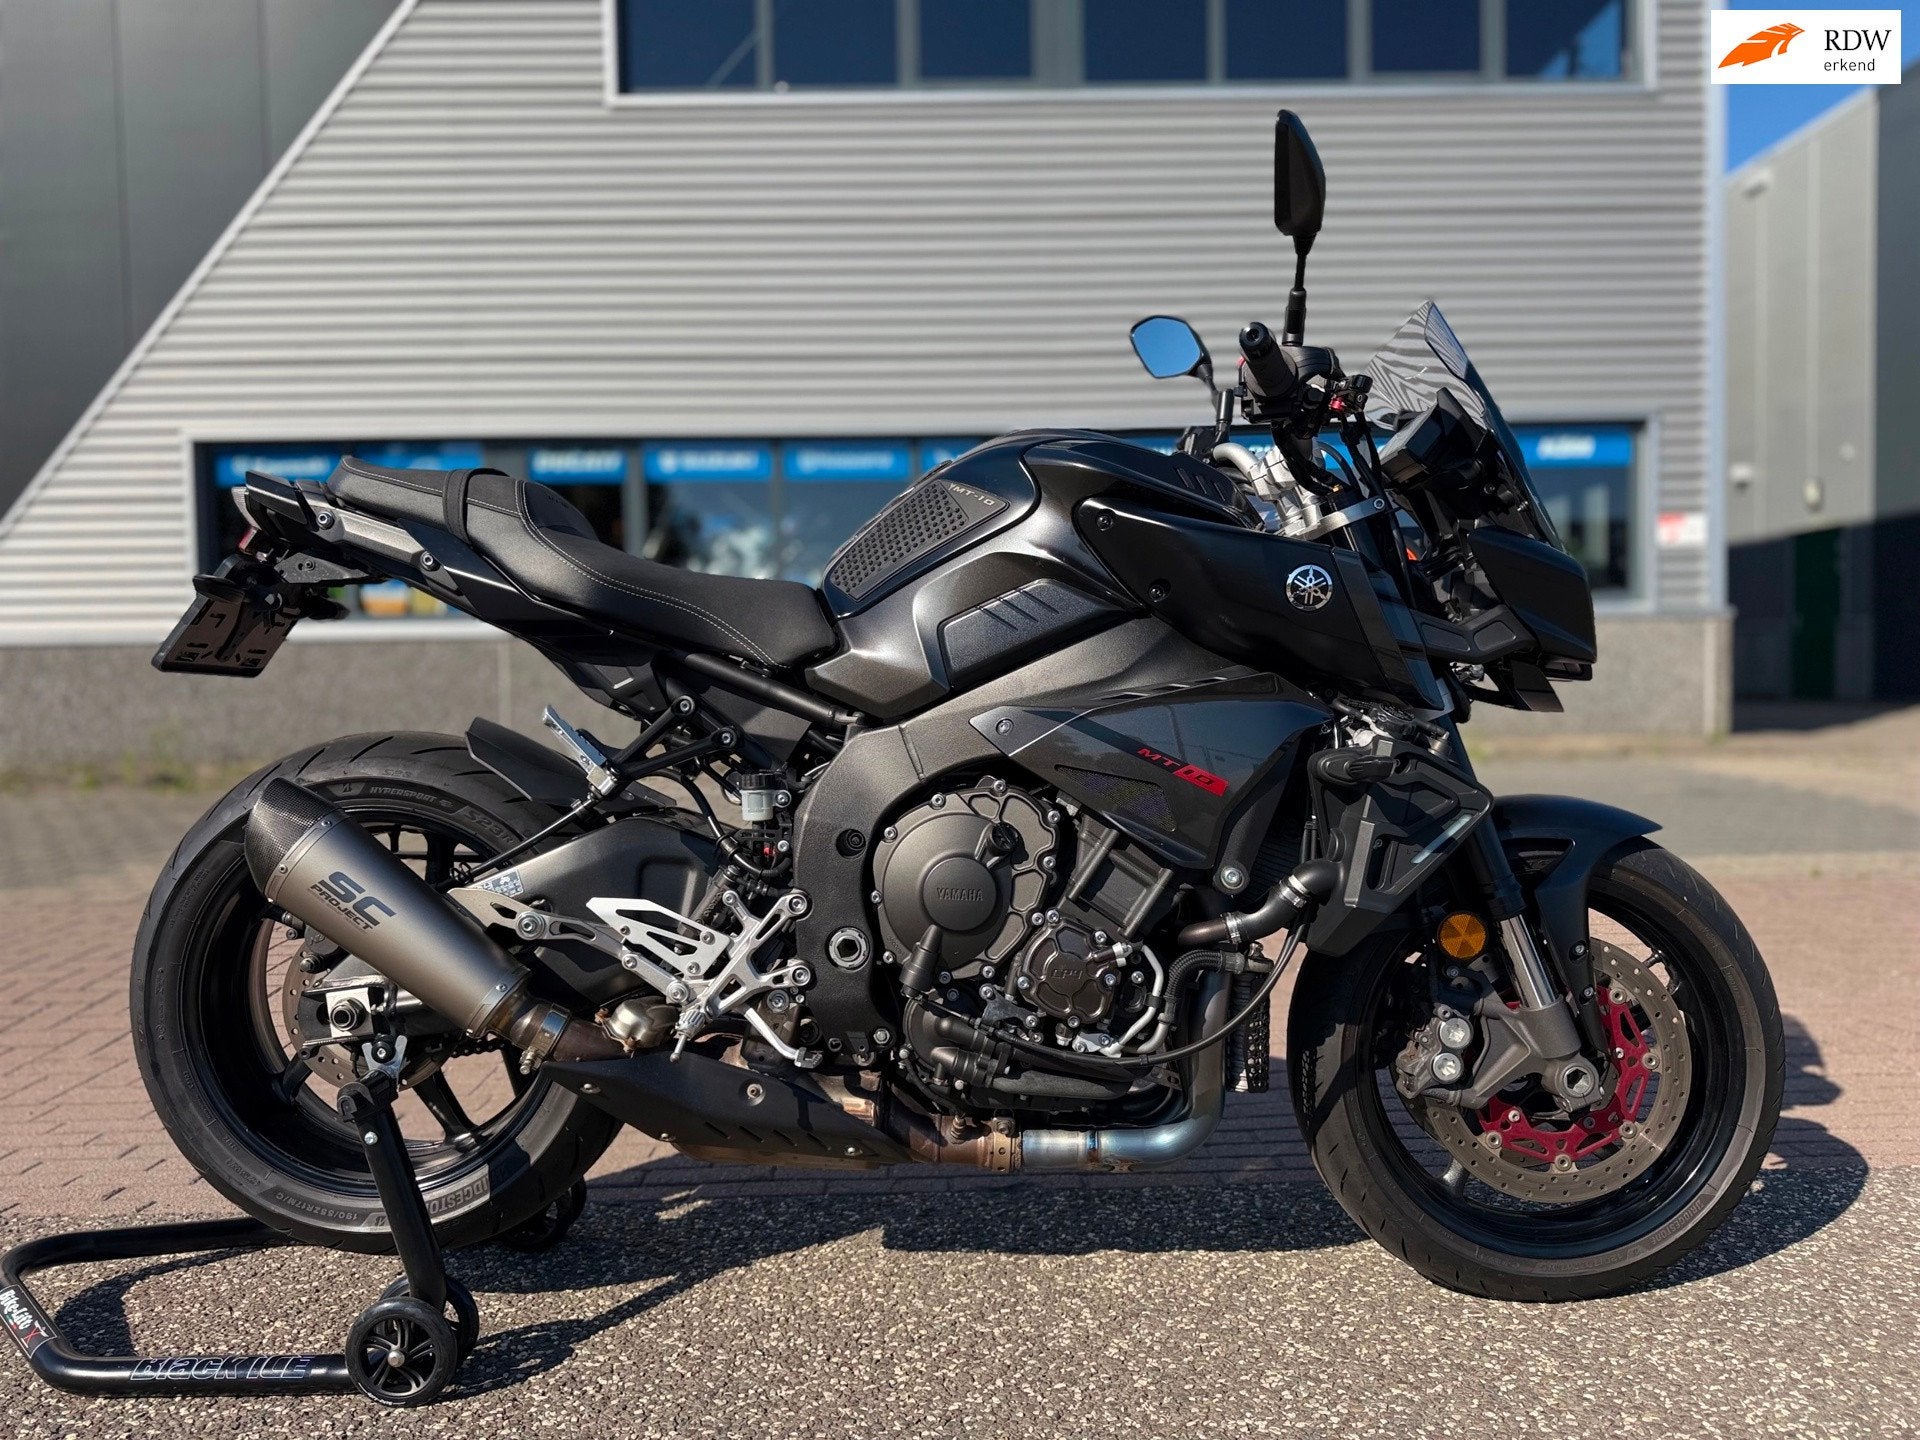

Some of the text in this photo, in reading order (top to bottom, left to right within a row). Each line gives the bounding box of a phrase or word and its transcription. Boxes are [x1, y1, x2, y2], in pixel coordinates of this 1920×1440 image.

[369, 786, 437, 803] HYPERSPORT
[310, 884, 374, 929] PROJECT
[318, 871, 398, 926] SC
[937, 887, 984, 902] YAMAHA
